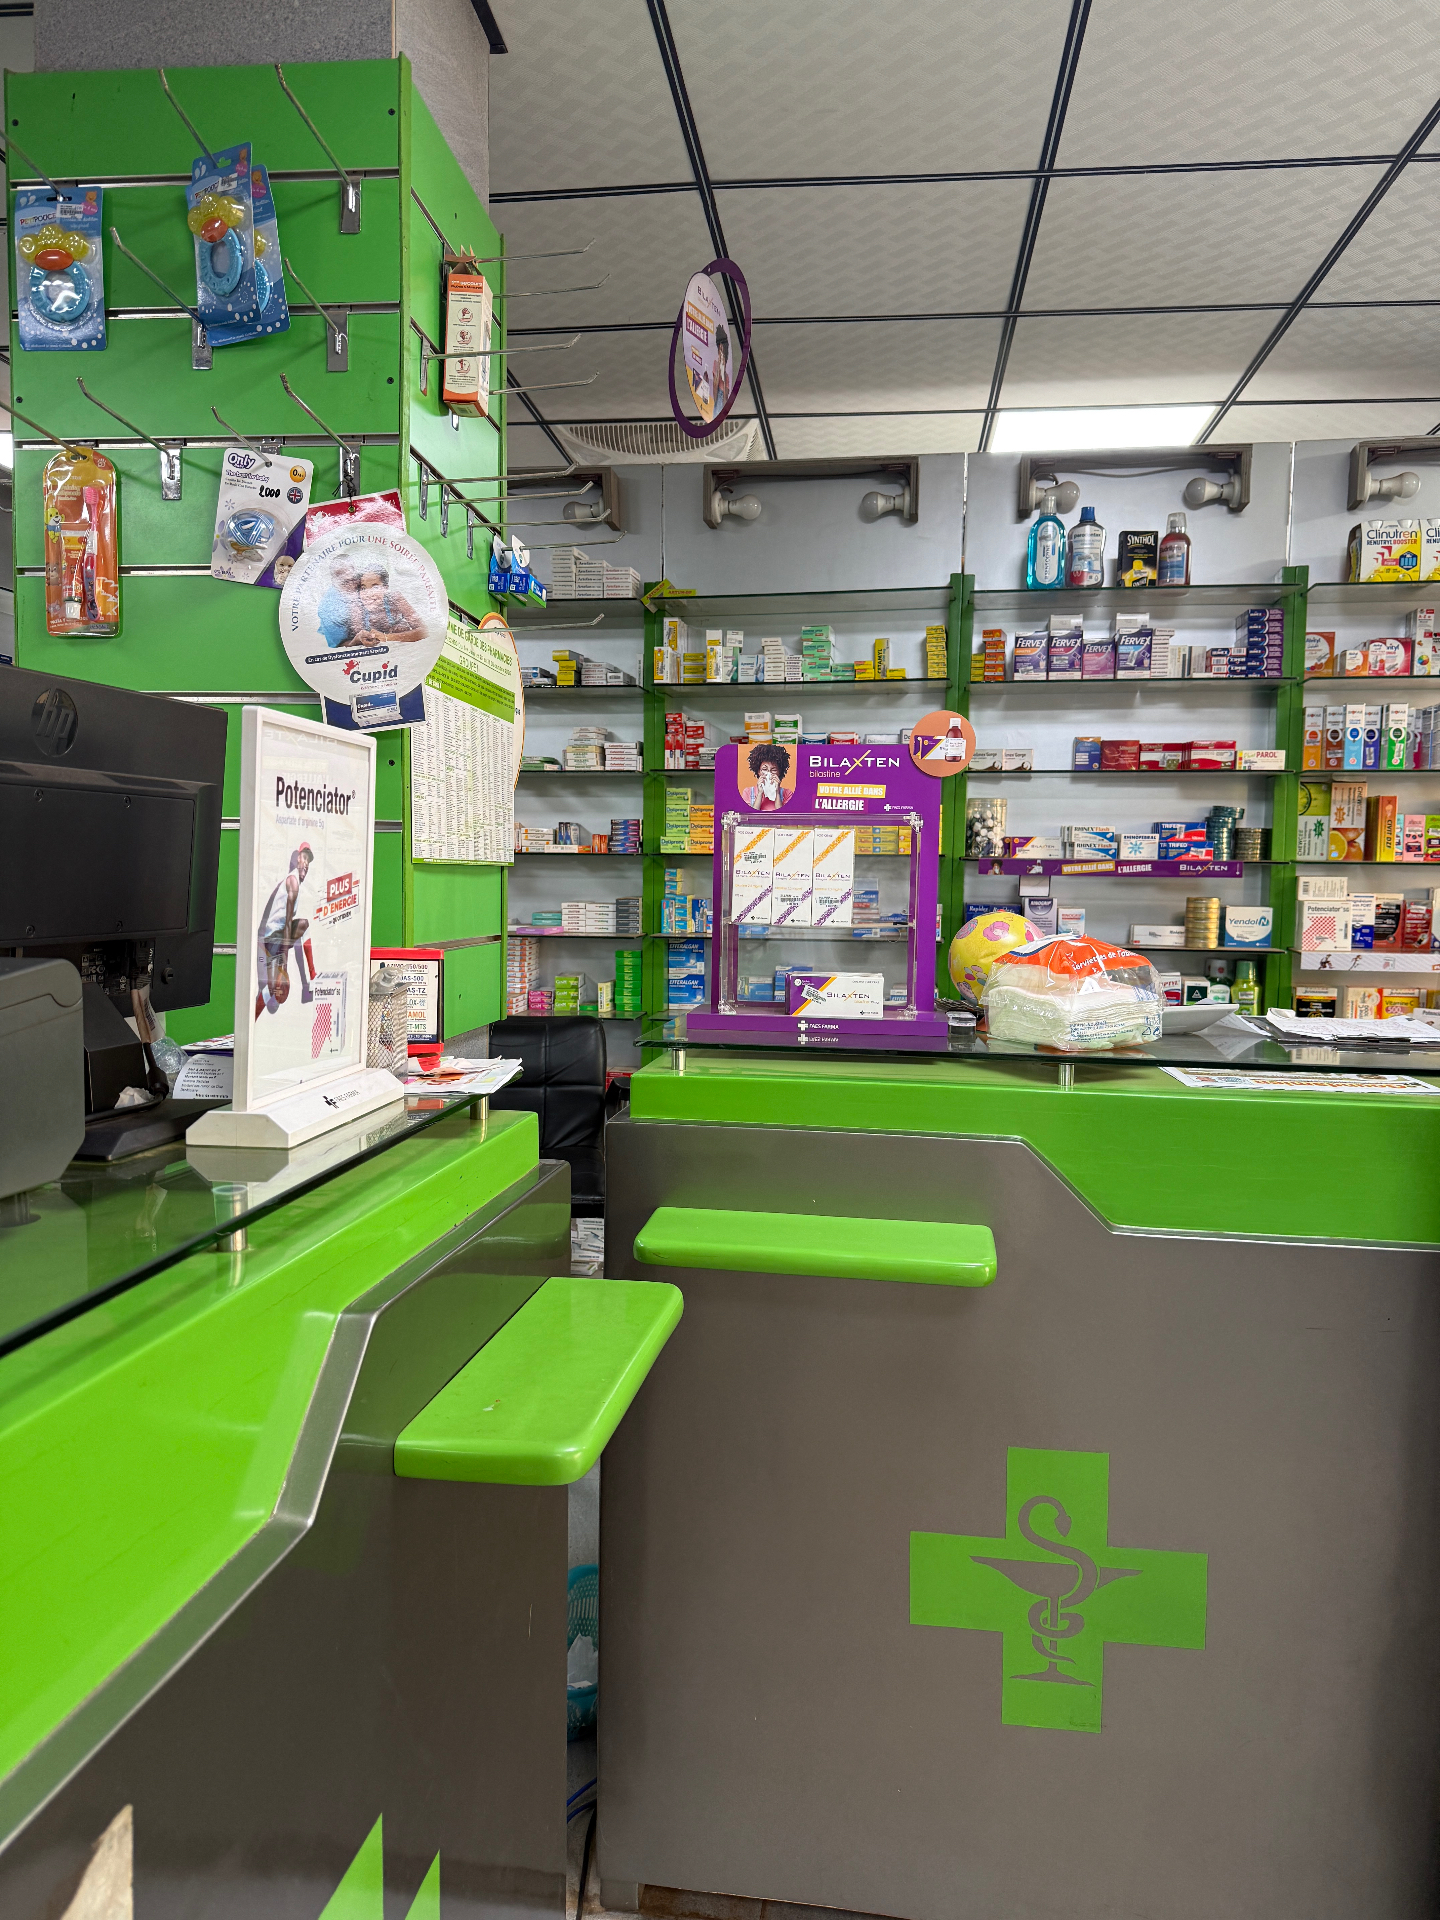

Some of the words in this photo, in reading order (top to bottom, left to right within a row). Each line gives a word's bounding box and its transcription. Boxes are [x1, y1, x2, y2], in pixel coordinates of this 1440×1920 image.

[228, 452, 255, 468] Only
[1366, 529, 1418, 540] Clinutren
[1426, 528, 1440, 538] Cli
[368, 535, 388, 546] UNE
[1127, 534, 1155, 546] SYNTHOL
[1016, 638, 1046, 648] FERVEX
[1052, 637, 1081, 648] FERVEX
[1120, 636, 1150, 646] FERVEX
[1085, 644, 1112, 654] FERVEX
[350, 663, 398, 684] Cupid
[36, 689, 75, 753] hp
[809, 751, 900, 772] BILAXTEN
[820, 786, 843, 794] VOTRE
[863, 787, 884, 796] DANS
[814, 799, 864, 810] L'ALLERGIE
[1118, 864, 1152, 874] L'ALLERGIE
[1180, 864, 1228, 873] BILAXTEN
[330, 879, 350, 897] PLUS
